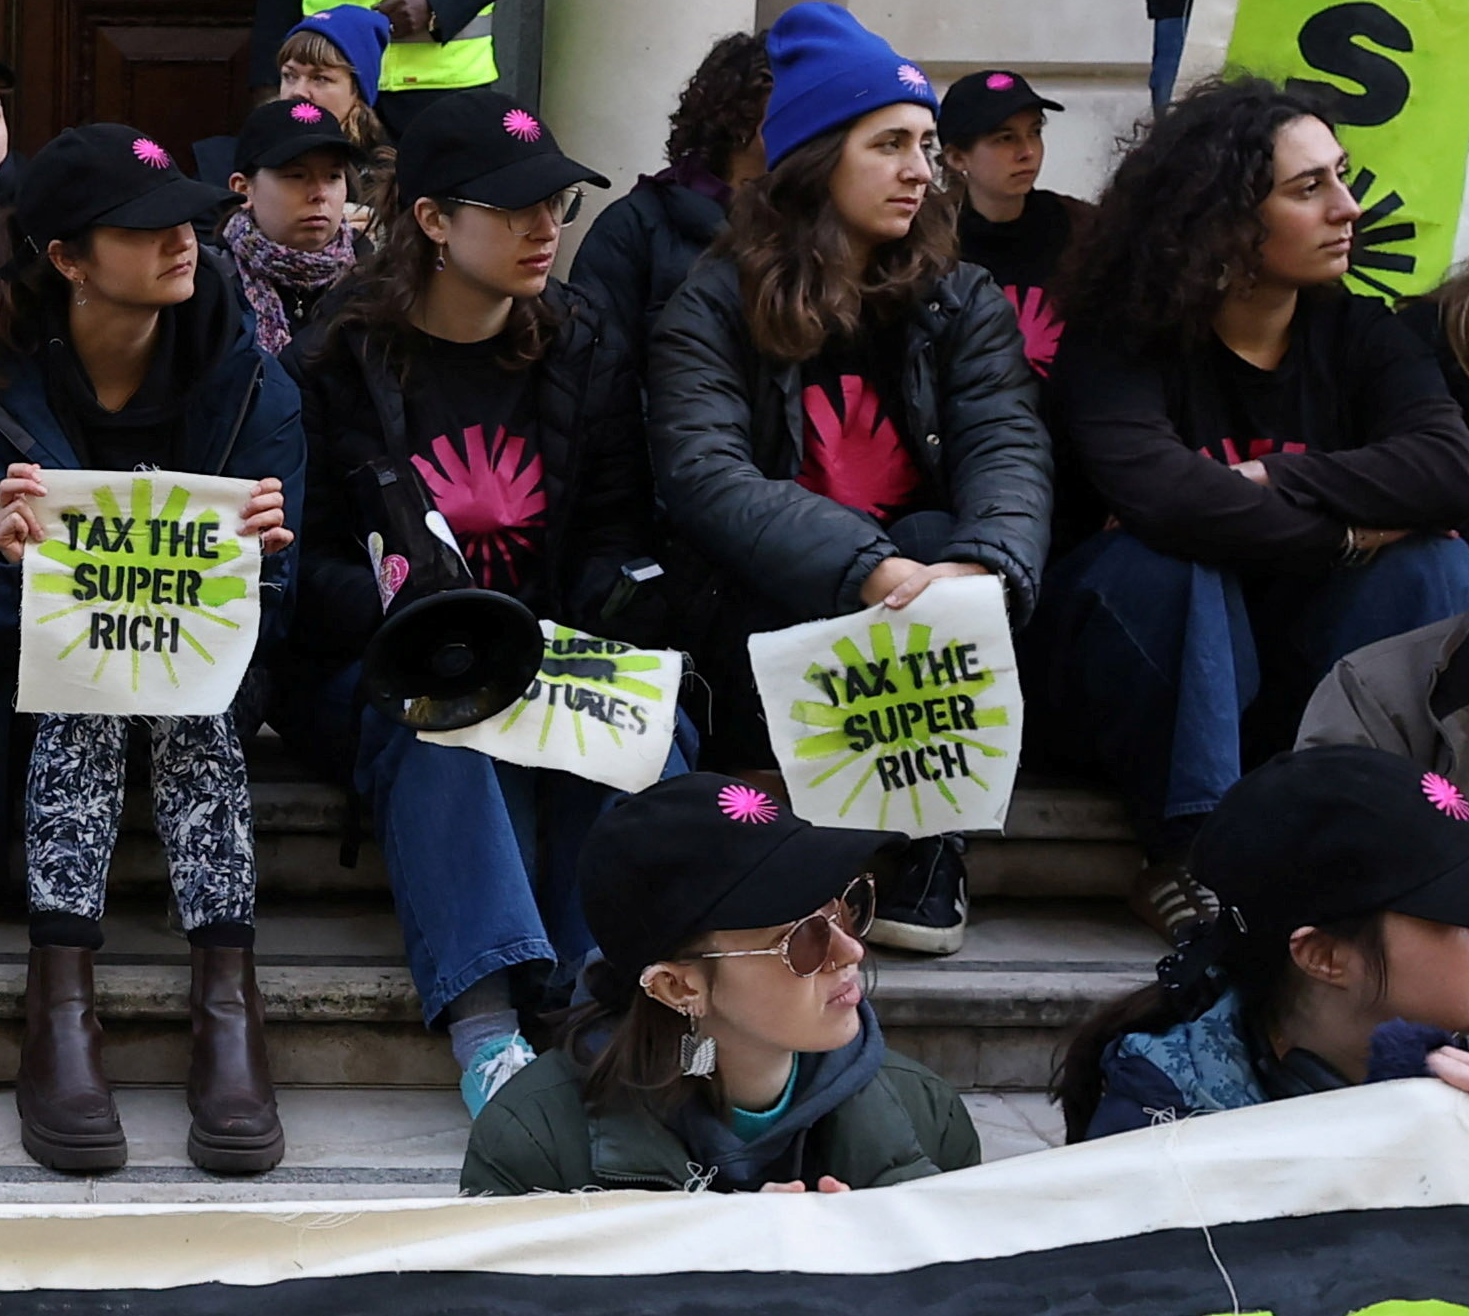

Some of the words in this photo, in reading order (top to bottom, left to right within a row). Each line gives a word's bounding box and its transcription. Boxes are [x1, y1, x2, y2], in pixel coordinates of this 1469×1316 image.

[61, 513, 135, 553] TAX
[145, 518, 219, 559] THE
[72, 563, 202, 606] SUPER
[89, 612, 179, 653] RICH
[812, 658, 897, 707] TAX
[900, 643, 984, 689] THE
[843, 694, 978, 752] SUPER
[876, 742, 969, 792] RICH
